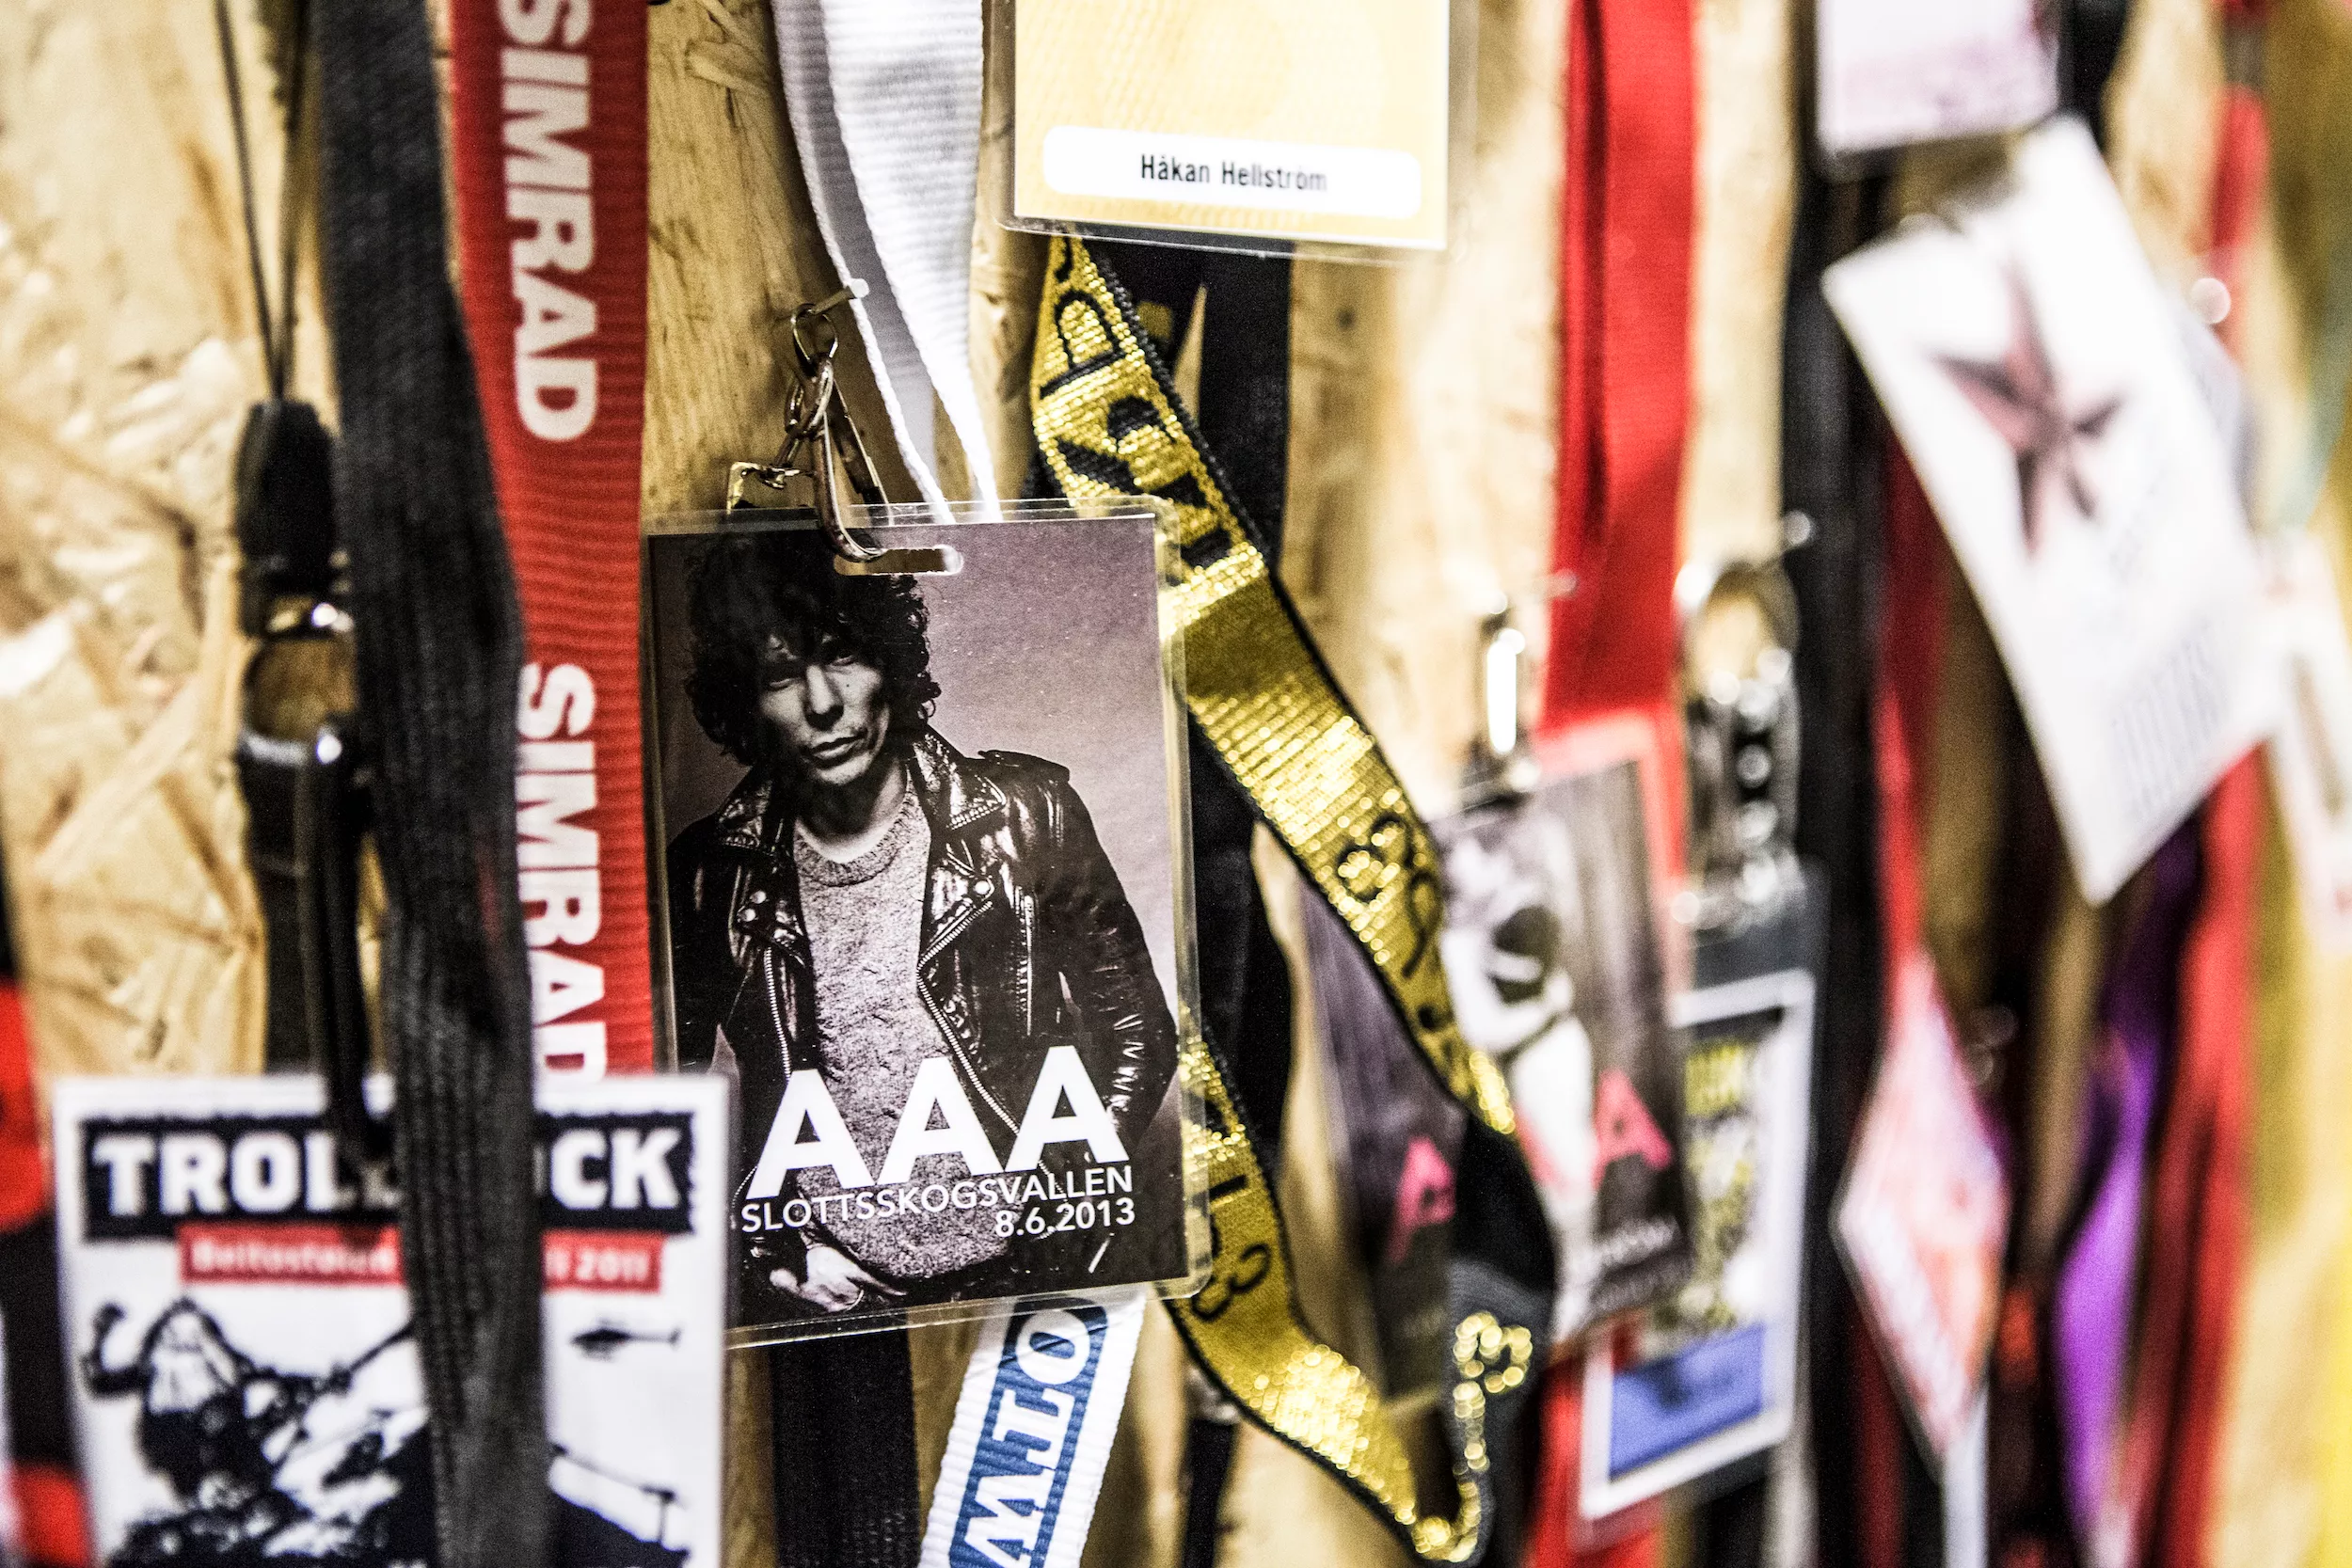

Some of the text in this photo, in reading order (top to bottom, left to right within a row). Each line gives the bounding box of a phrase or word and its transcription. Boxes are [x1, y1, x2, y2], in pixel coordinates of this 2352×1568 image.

[1140, 153, 1327, 192] Håkan Hellström
[498, 0, 597, 440] SIMRAD
[516, 663, 607, 1081] SIMRAD
[745, 1045, 1129, 1200] AAA
[741, 1165, 1132, 1233] SLOTTSSKOGSVALLEN
[994, 1196, 1136, 1238] 8.6.2013
[575, 1246, 649, 1282] 2011
